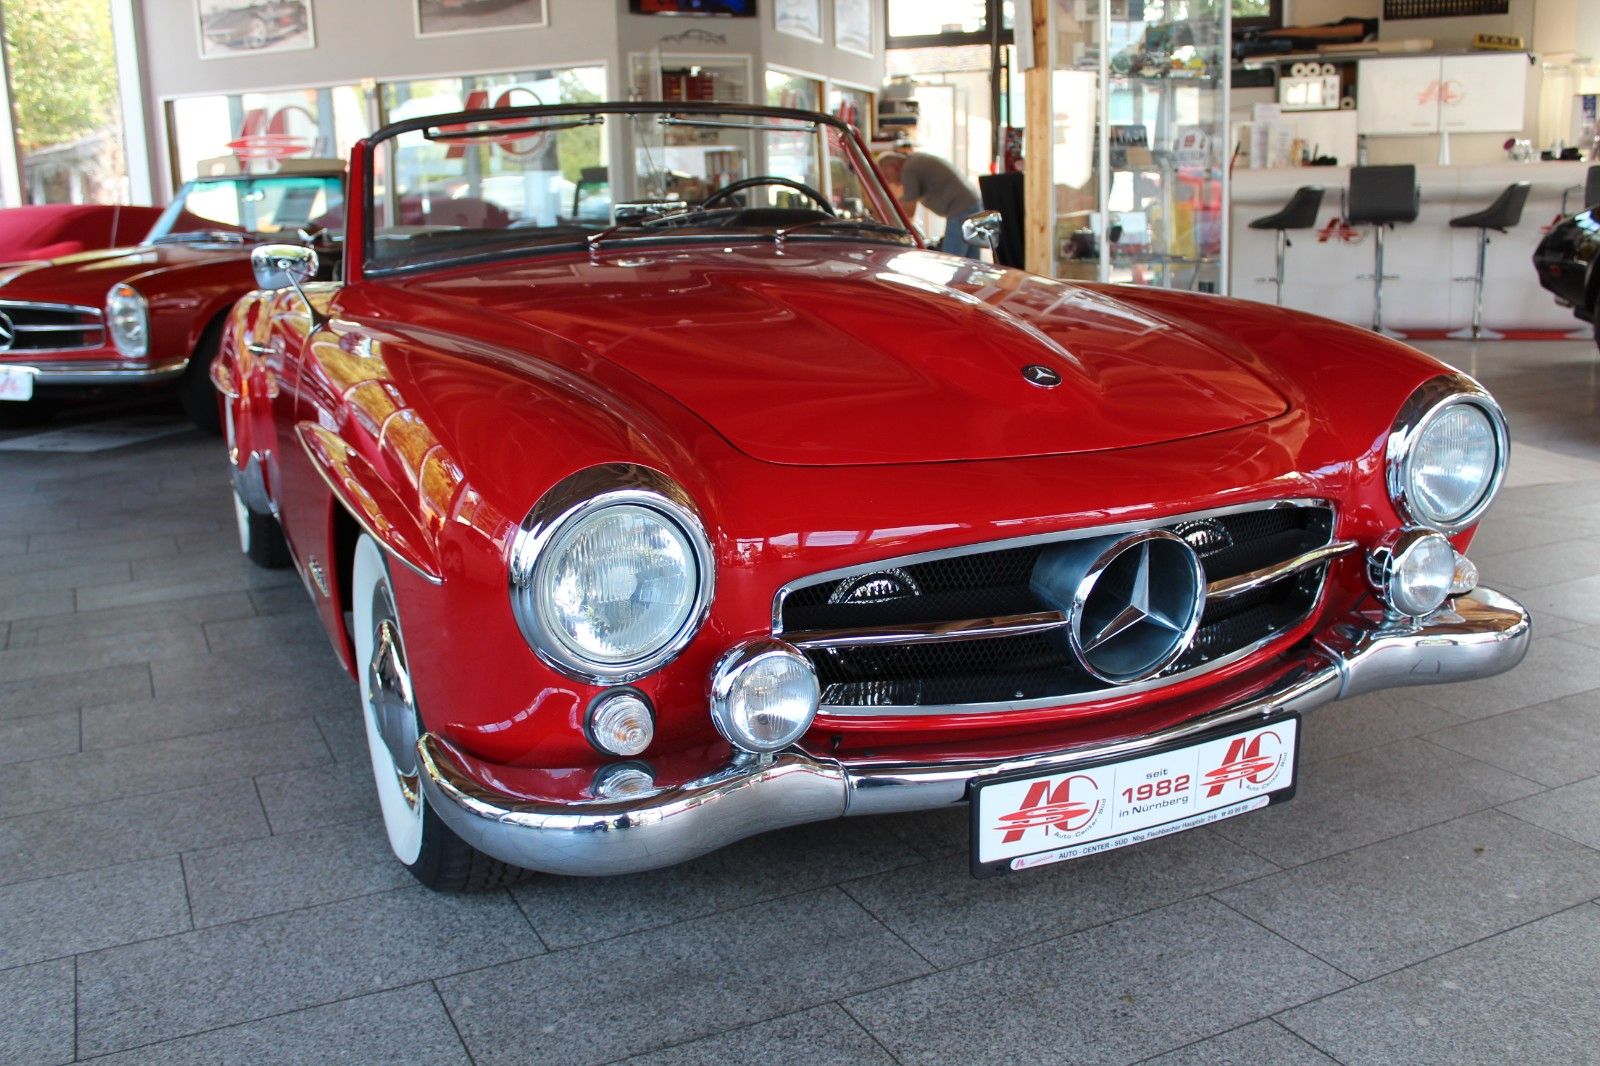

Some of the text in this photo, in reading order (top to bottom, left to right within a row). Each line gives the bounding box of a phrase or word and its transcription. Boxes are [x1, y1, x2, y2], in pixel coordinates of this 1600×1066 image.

[1145, 768, 1168, 779] seit
[1122, 774, 1190, 804] 1982
[1119, 795, 1189, 818] in Nürnberg
[1058, 848, 1078, 859] AUTO
[1082, 842, 1110, 854] CENTER
